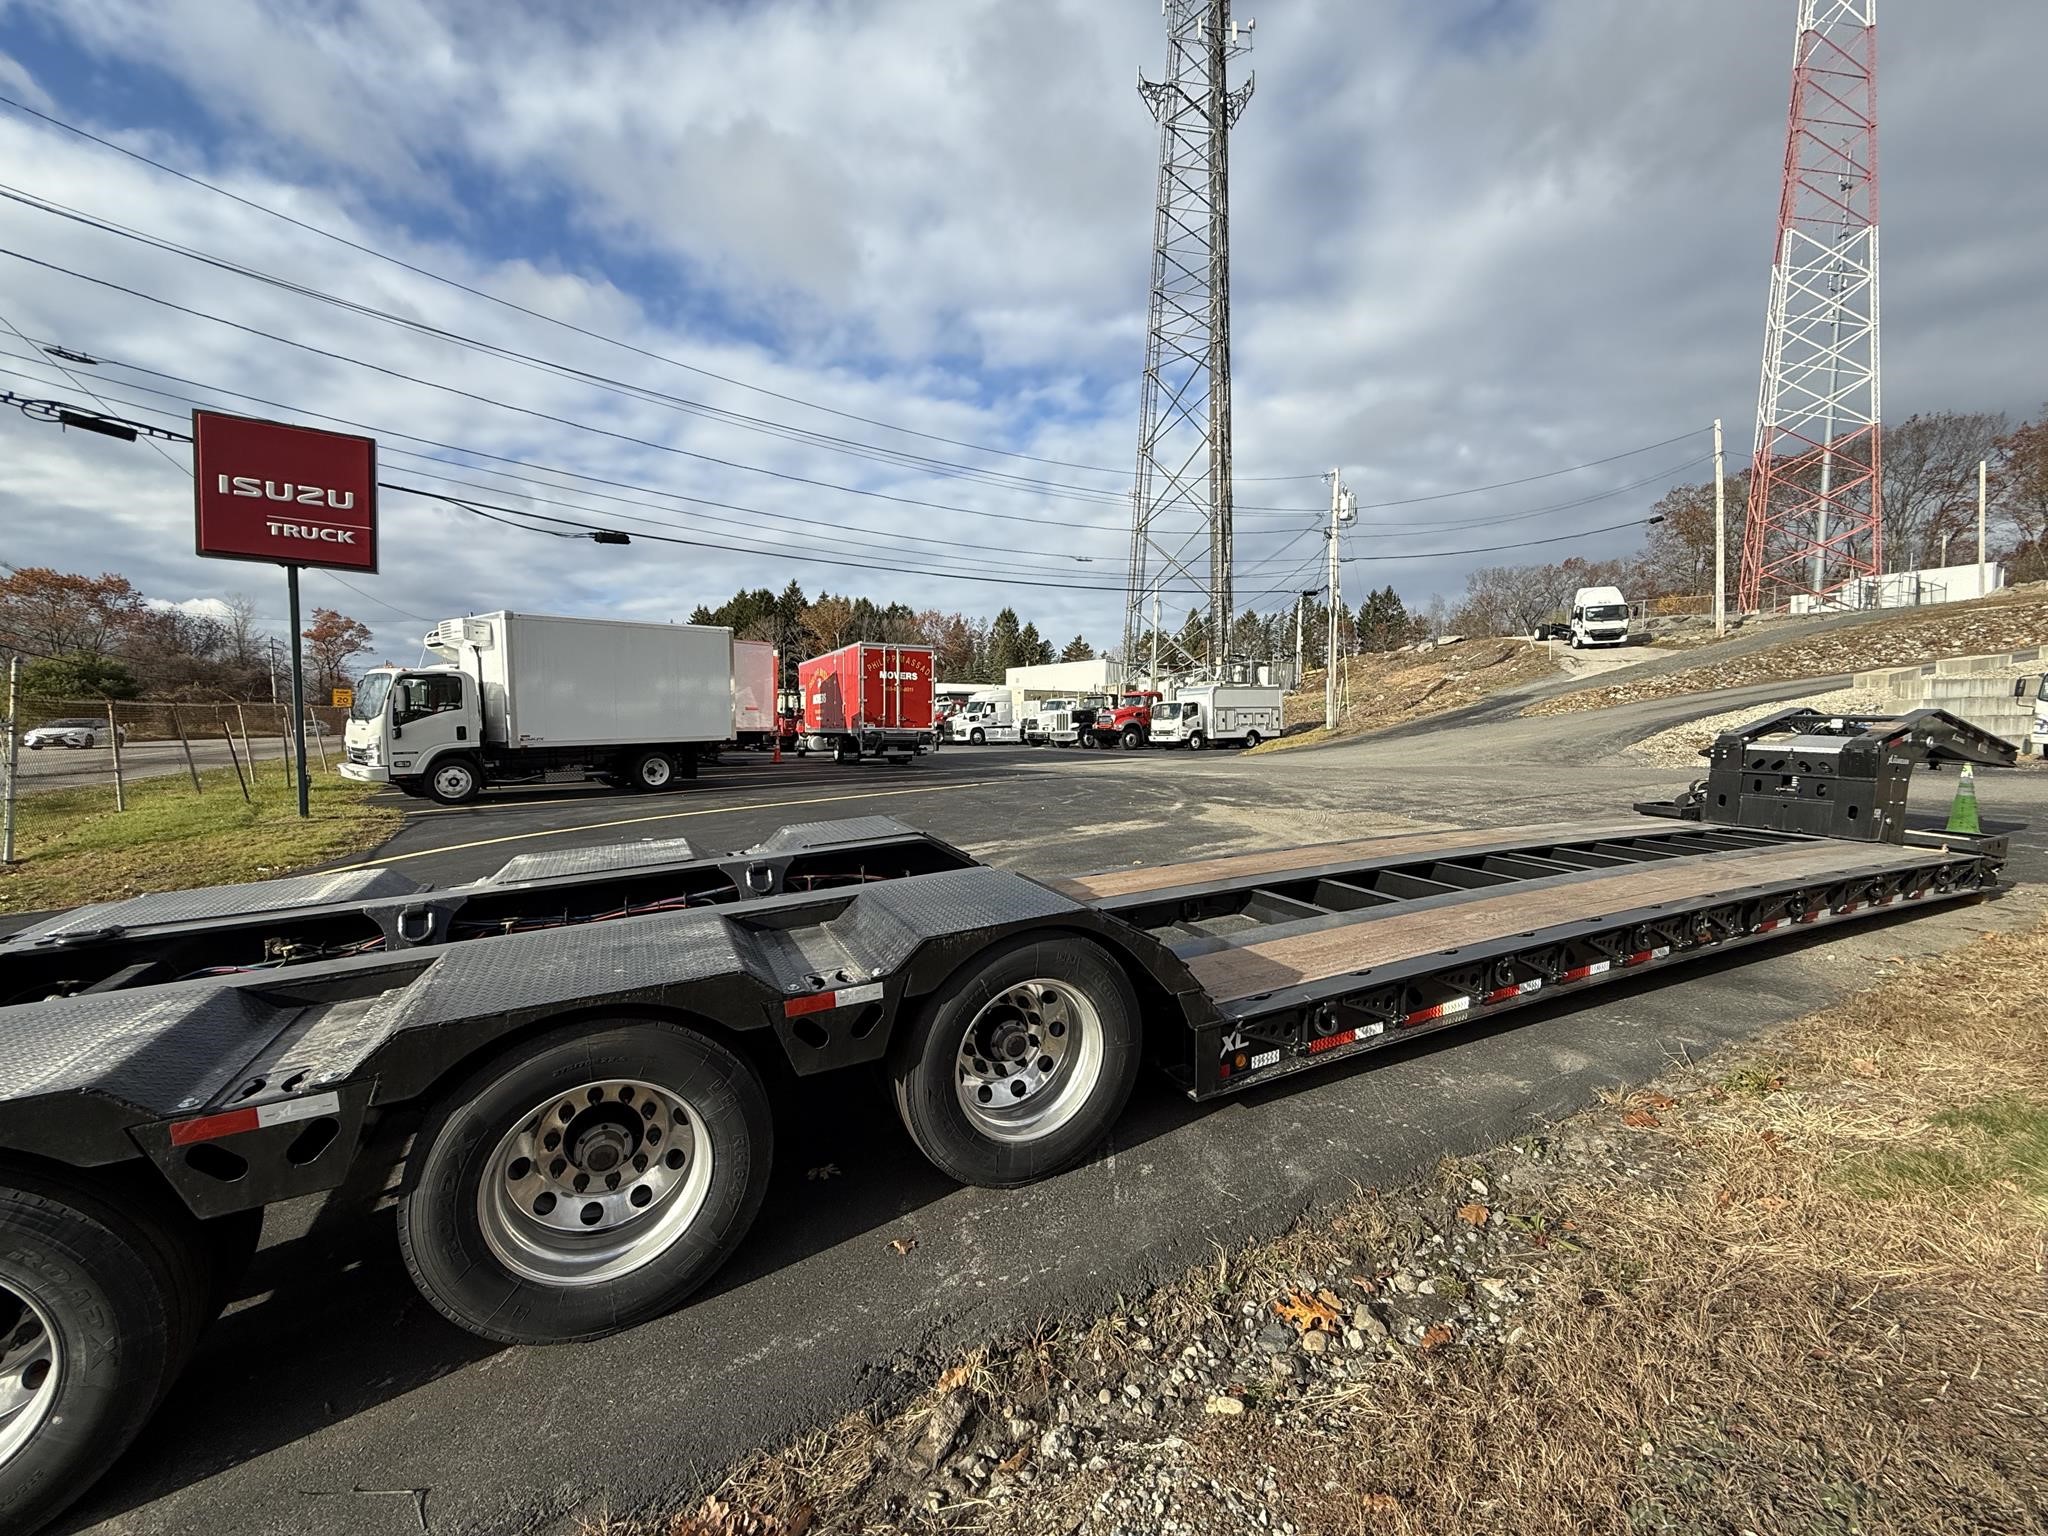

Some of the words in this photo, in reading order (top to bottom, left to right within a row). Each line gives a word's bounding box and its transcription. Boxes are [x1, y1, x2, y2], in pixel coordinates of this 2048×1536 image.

[218, 474, 354, 510] ISUZU
[266, 521, 356, 544] TRUCK
[866, 656, 891, 675] PHILP
[879, 670, 918, 681] MOVERS
[1220, 1026, 1249, 1060] XL
